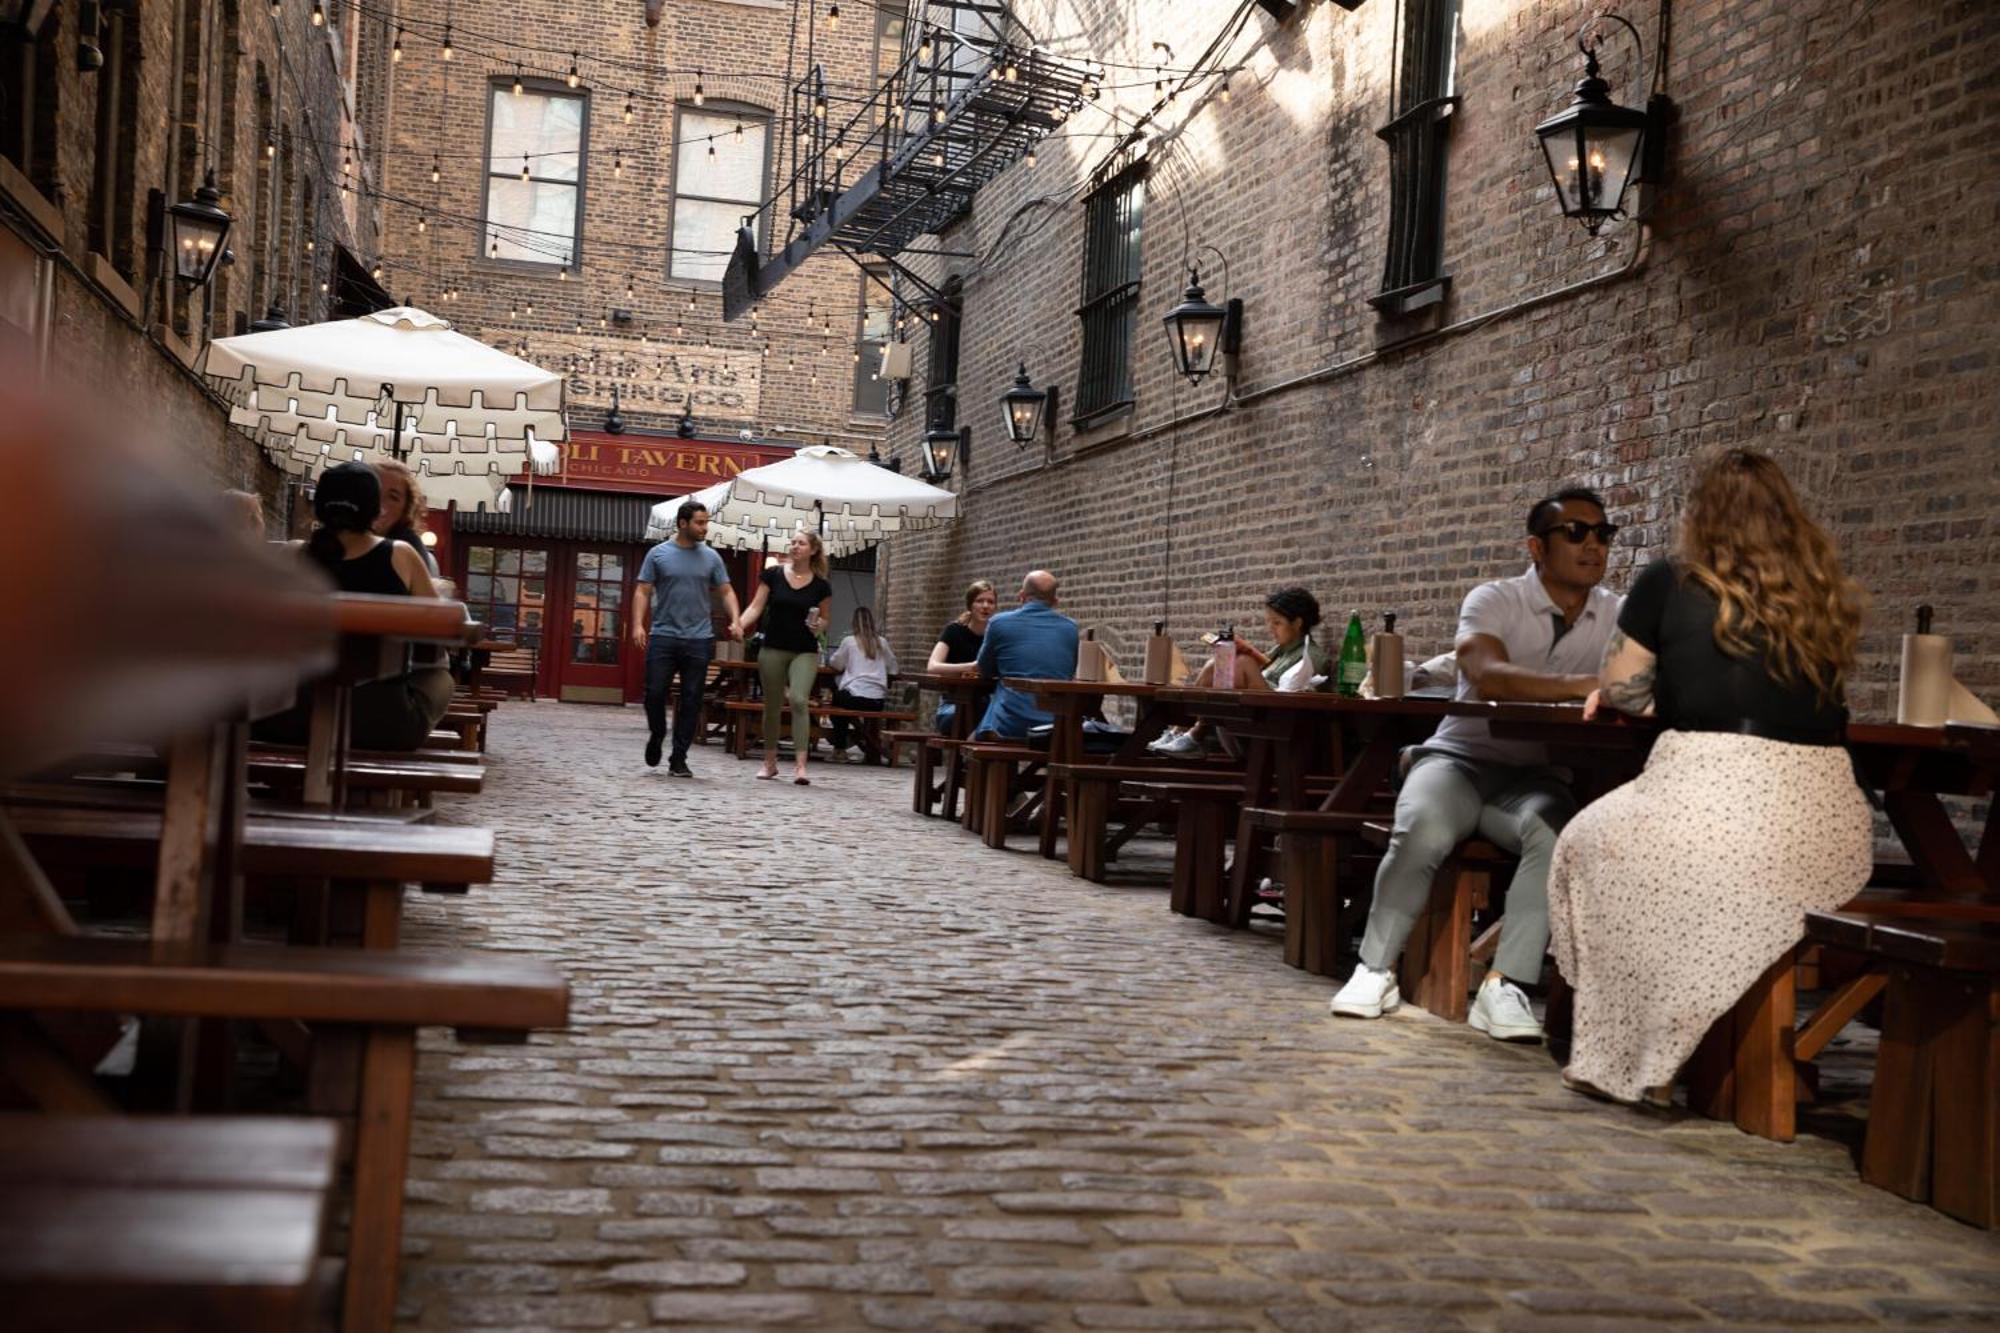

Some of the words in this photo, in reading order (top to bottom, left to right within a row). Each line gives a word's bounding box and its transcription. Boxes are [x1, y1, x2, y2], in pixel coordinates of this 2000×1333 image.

[561, 443, 600, 461] LI
[616, 447, 746, 478] TAVERN
[568, 463, 649, 477] CHICAGO
